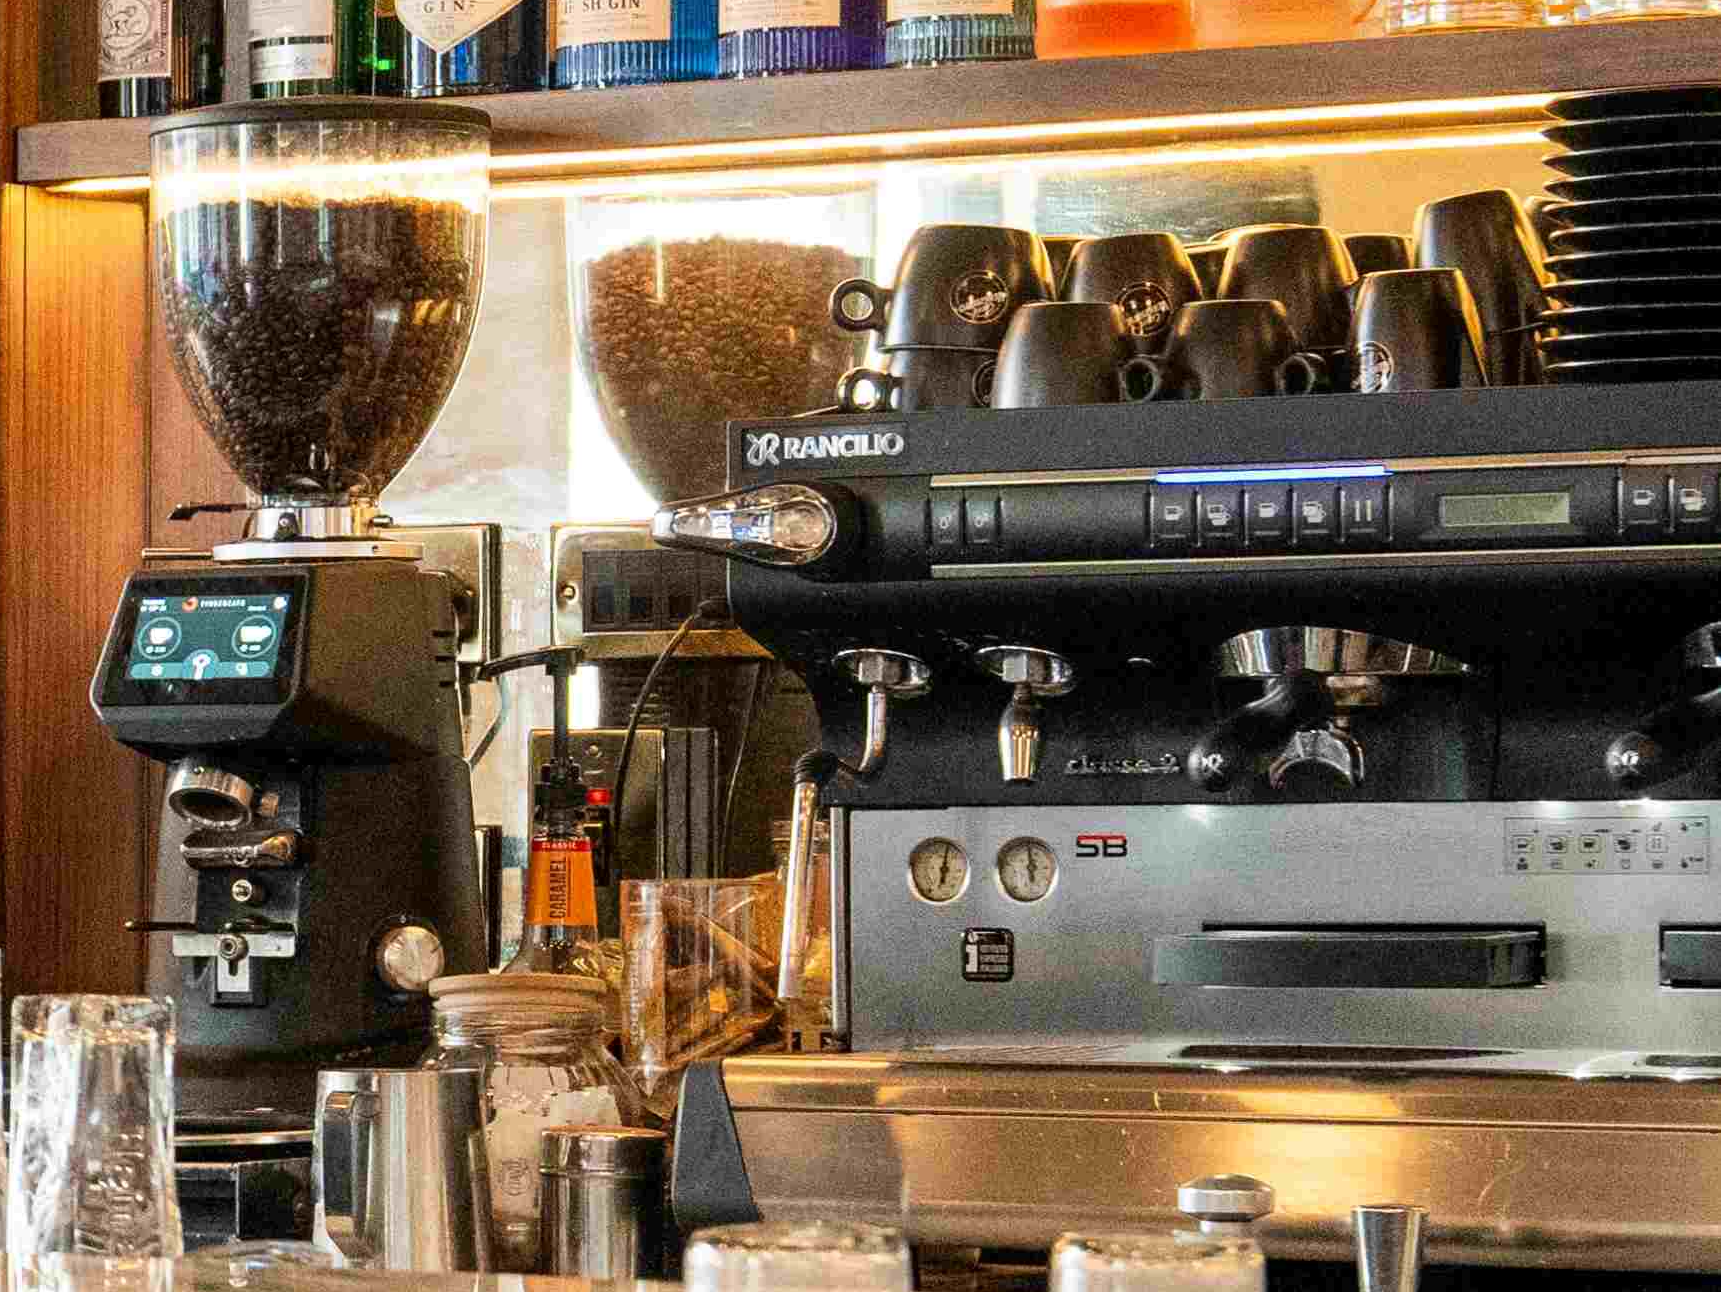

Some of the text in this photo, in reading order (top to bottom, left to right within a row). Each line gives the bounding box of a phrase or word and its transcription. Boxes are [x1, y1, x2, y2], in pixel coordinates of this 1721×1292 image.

[424, 0, 464, 13] GIN
[784, 432, 904, 460] RANCILIO
[549, 854, 567, 920] CARAMEL
